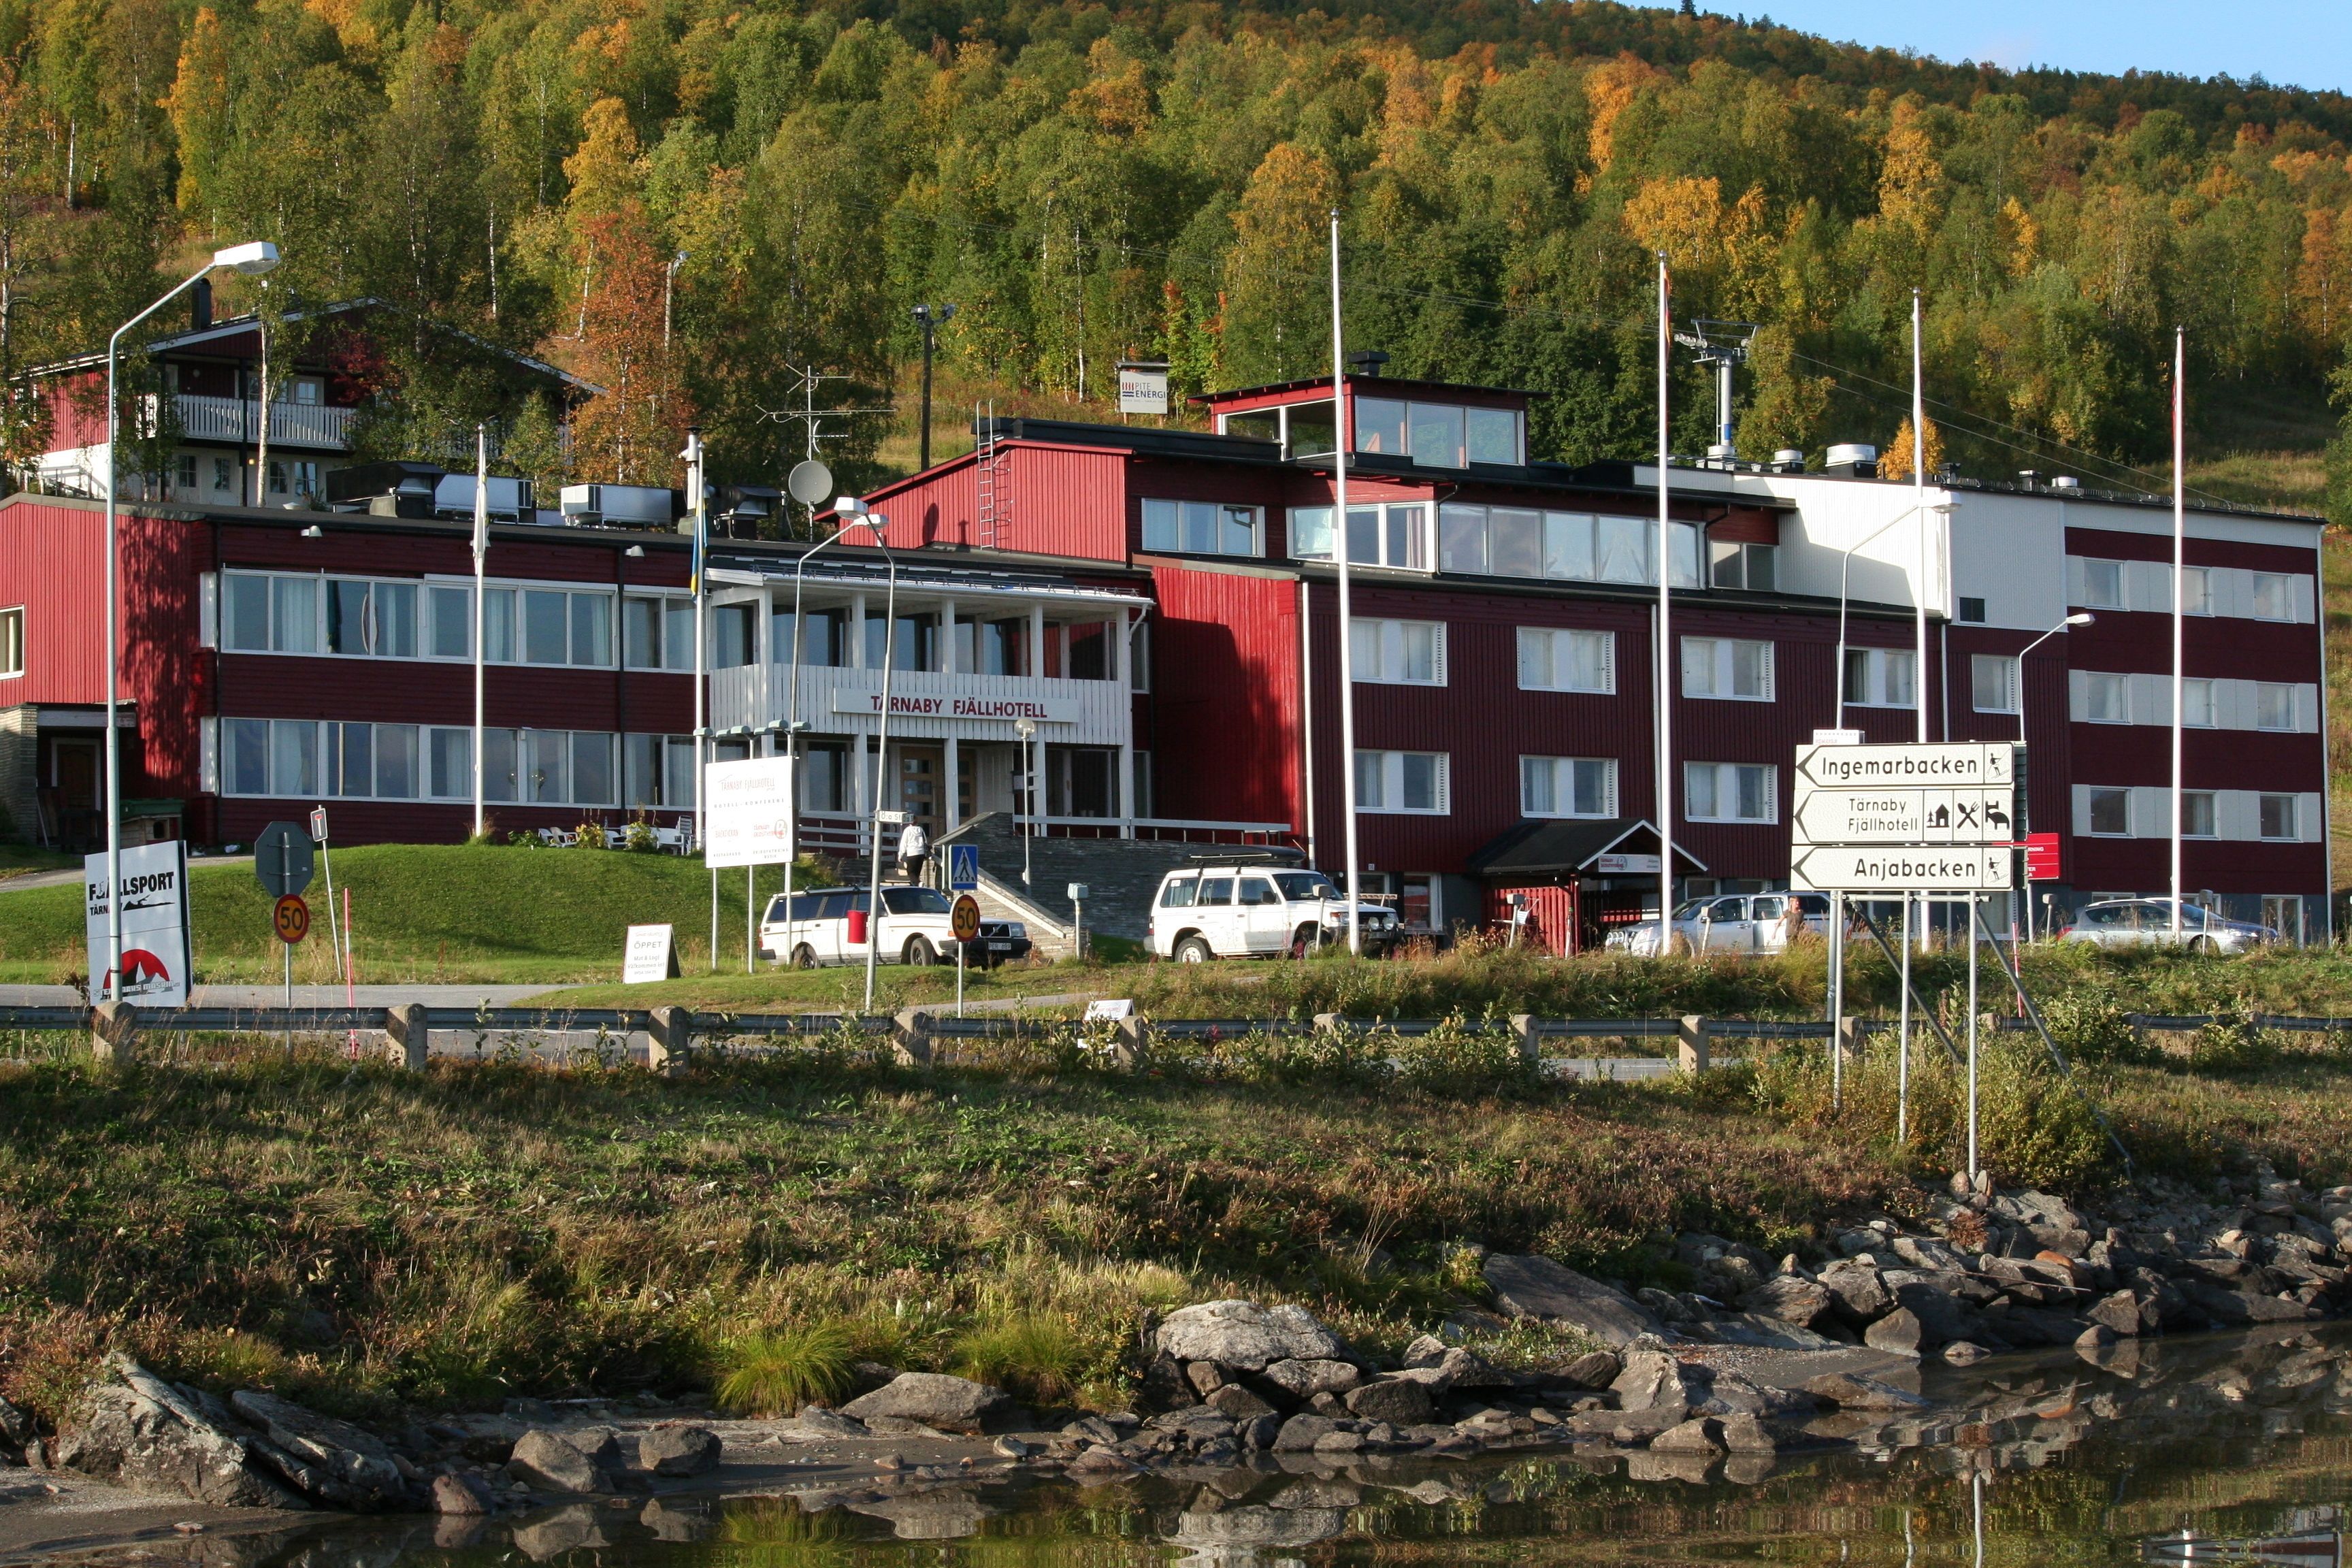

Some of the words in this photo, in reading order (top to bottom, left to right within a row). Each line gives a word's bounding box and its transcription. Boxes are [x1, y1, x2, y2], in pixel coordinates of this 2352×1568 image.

[1135, 382, 1150, 391] PITE
[1135, 390, 1166, 399] ENERGI
[953, 696, 1048, 718] FJÄLLHOTELL
[1823, 755, 1977, 780] Ingemarbacken
[1849, 798, 1906, 814] Tärnaby
[1848, 818, 1918, 834] Fjällhotell
[1855, 858, 1975, 881] Anjabacken
[280, 906, 304, 931] 50
[957, 906, 976, 930] 50
[634, 941, 662, 949] ÖPPET
